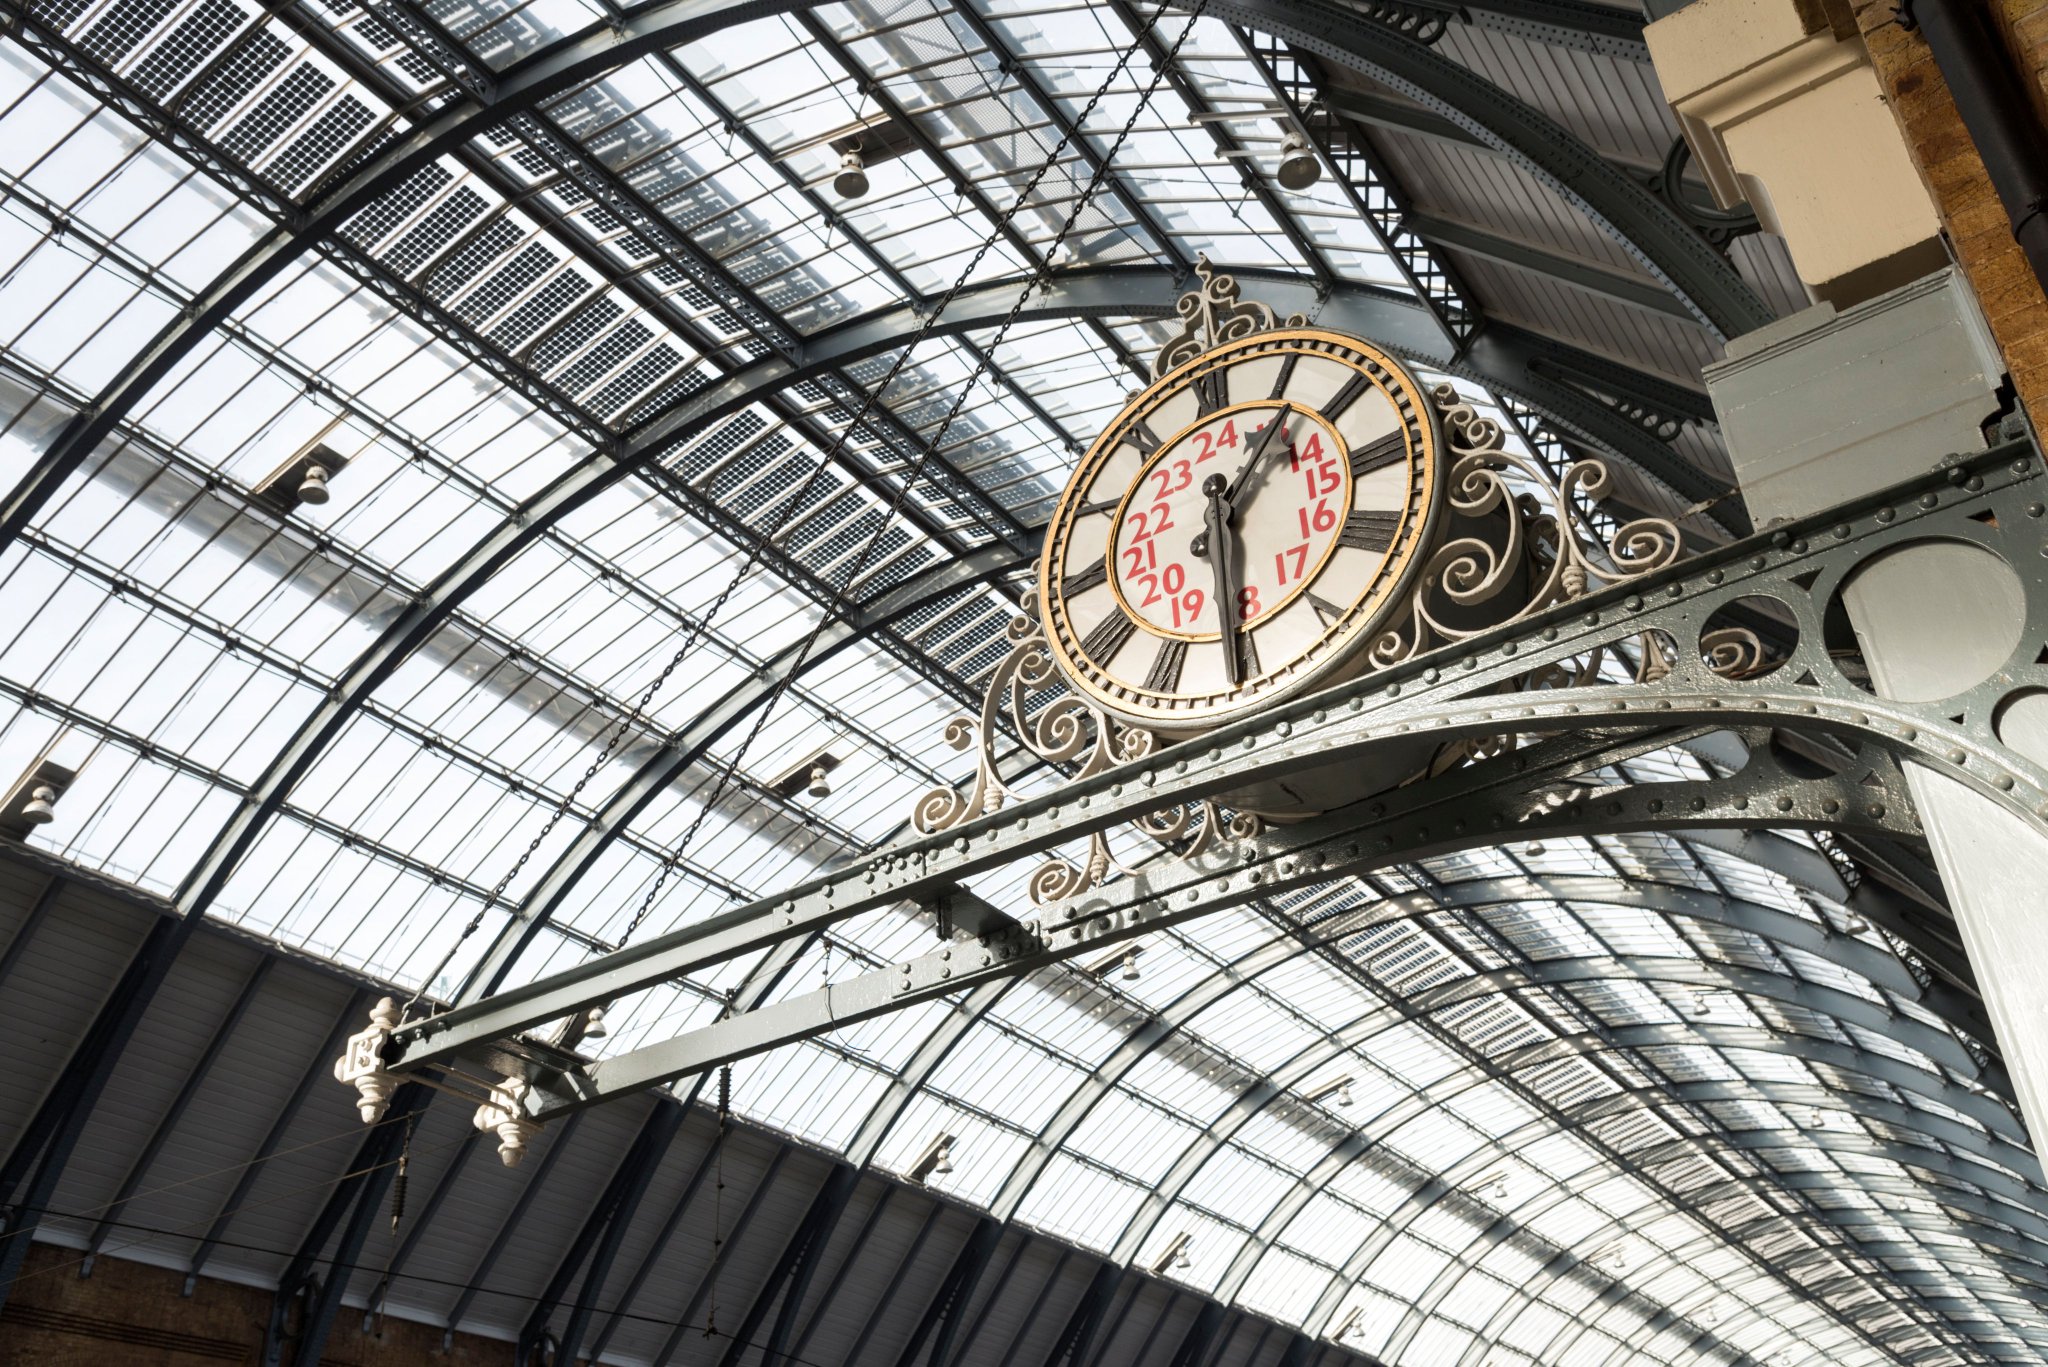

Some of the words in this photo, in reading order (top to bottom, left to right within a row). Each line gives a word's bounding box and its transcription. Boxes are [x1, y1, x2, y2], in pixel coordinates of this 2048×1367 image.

[1192, 418, 1239, 465] 24
[1290, 432, 1325, 474] 14
[1350, 426, 1407, 477] III
[1151, 459, 1193, 502] 23
[1305, 458, 1342, 501] 15
[1127, 501, 1175, 545] 22
[1298, 497, 1337, 540] 16
[1336, 509, 1404, 555] IIII
[1122, 539, 1157, 581] 21
[1275, 543, 1310, 587] 17
[1137, 562, 1186, 608] 20
[1237, 585, 1262, 621] 8
[1171, 588, 1205, 629] 19
